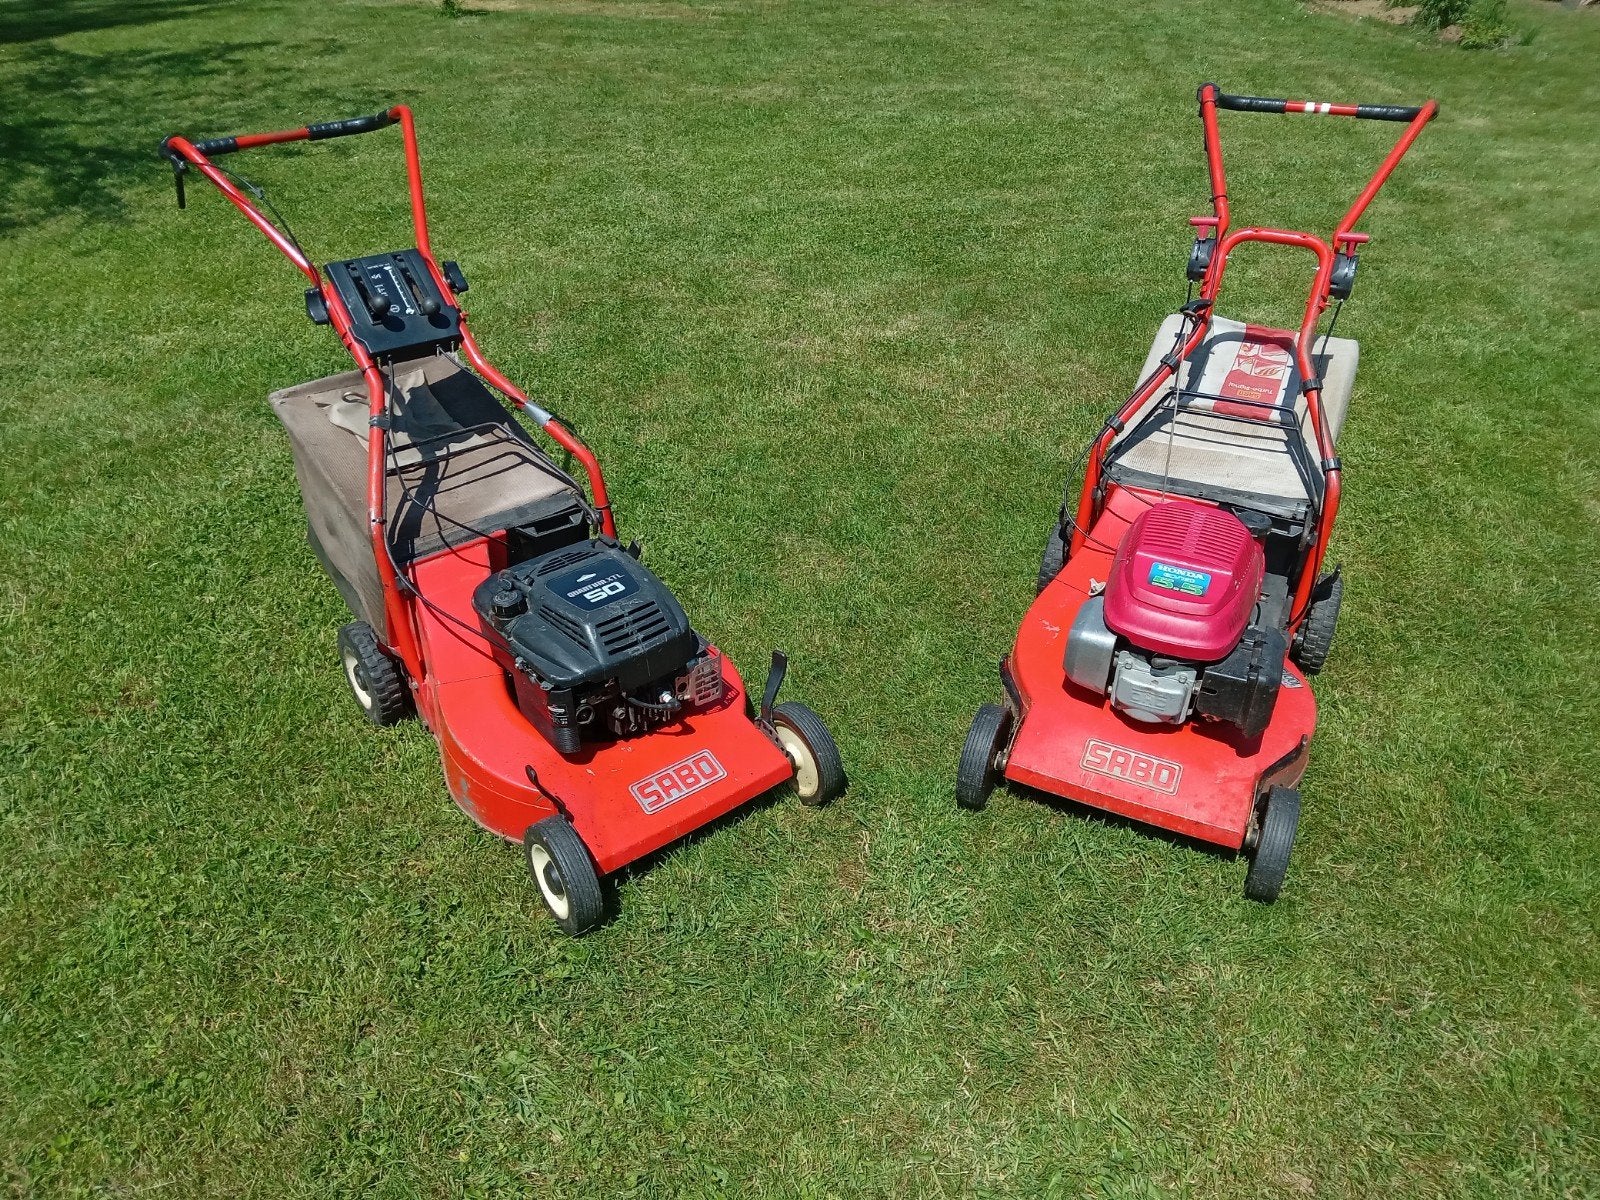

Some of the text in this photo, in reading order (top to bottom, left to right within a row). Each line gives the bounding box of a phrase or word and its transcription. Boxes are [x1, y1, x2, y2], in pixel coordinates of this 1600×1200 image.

[1157, 564, 1204, 580] HONDA
[566, 573, 625, 598] QUANTUM XTL
[583, 581, 626, 603] 50
[1085, 743, 1176, 789] SABO
[636, 755, 720, 808] SABO
